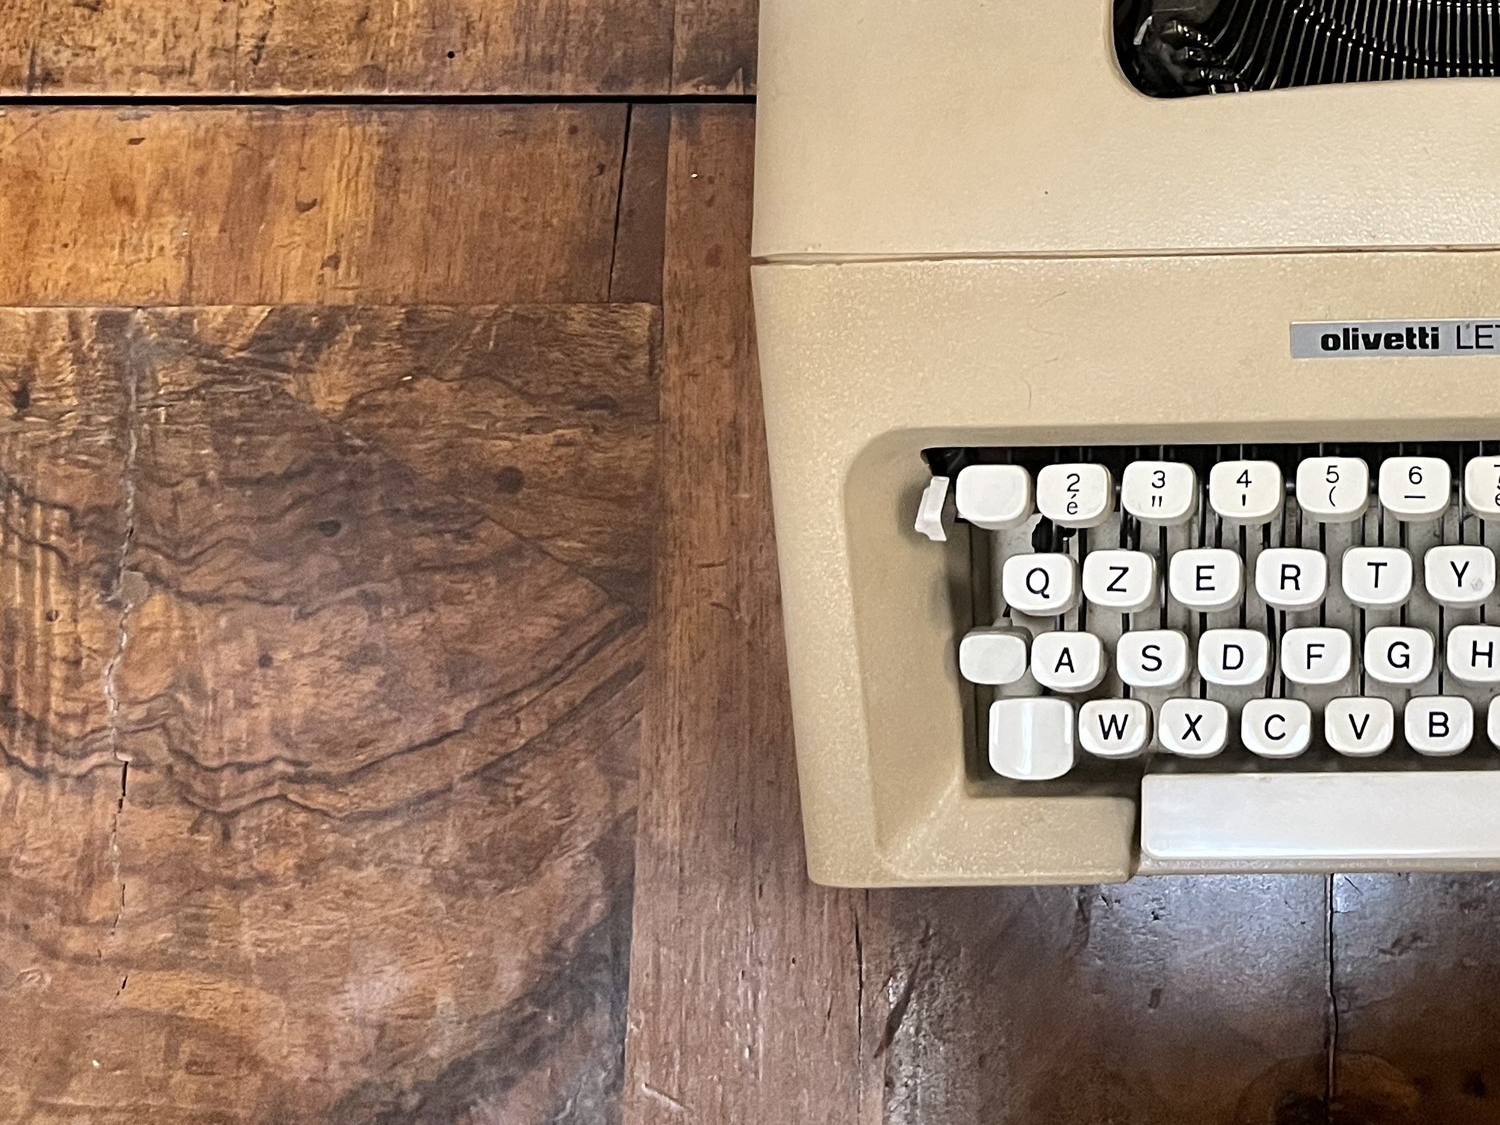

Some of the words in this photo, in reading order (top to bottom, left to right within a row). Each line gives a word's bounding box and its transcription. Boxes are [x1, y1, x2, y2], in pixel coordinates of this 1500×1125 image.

[1320, 326, 1440, 351] olivetti
[1066, 473, 1081, 493] 2
[1151, 470, 1166, 489] 3
[1236, 469, 1253, 489] 4
[1325, 465, 1340, 484] 5
[1408, 465, 1423, 485] 6
[1066, 493, 1078, 516] é
[1328, 485, 1336, 507] (
[1025, 567, 1050, 599] Q
[1106, 565, 1130, 593] Z
[1195, 564, 1216, 592] E
[1280, 563, 1301, 591] R
[1366, 561, 1388, 589] T
[1450, 560, 1470, 588] Y
[1054, 646, 1075, 674] A
[1141, 644, 1163, 672] S
[1222, 643, 1244, 671] D
[1306, 643, 1325, 670] F
[1387, 641, 1410, 670] G
[1471, 640, 1494, 669] H
[1098, 713, 1129, 741] W
[1181, 713, 1203, 742] X
[1264, 713, 1286, 741] C
[1348, 713, 1370, 740] V
[1428, 711, 1450, 738] B
